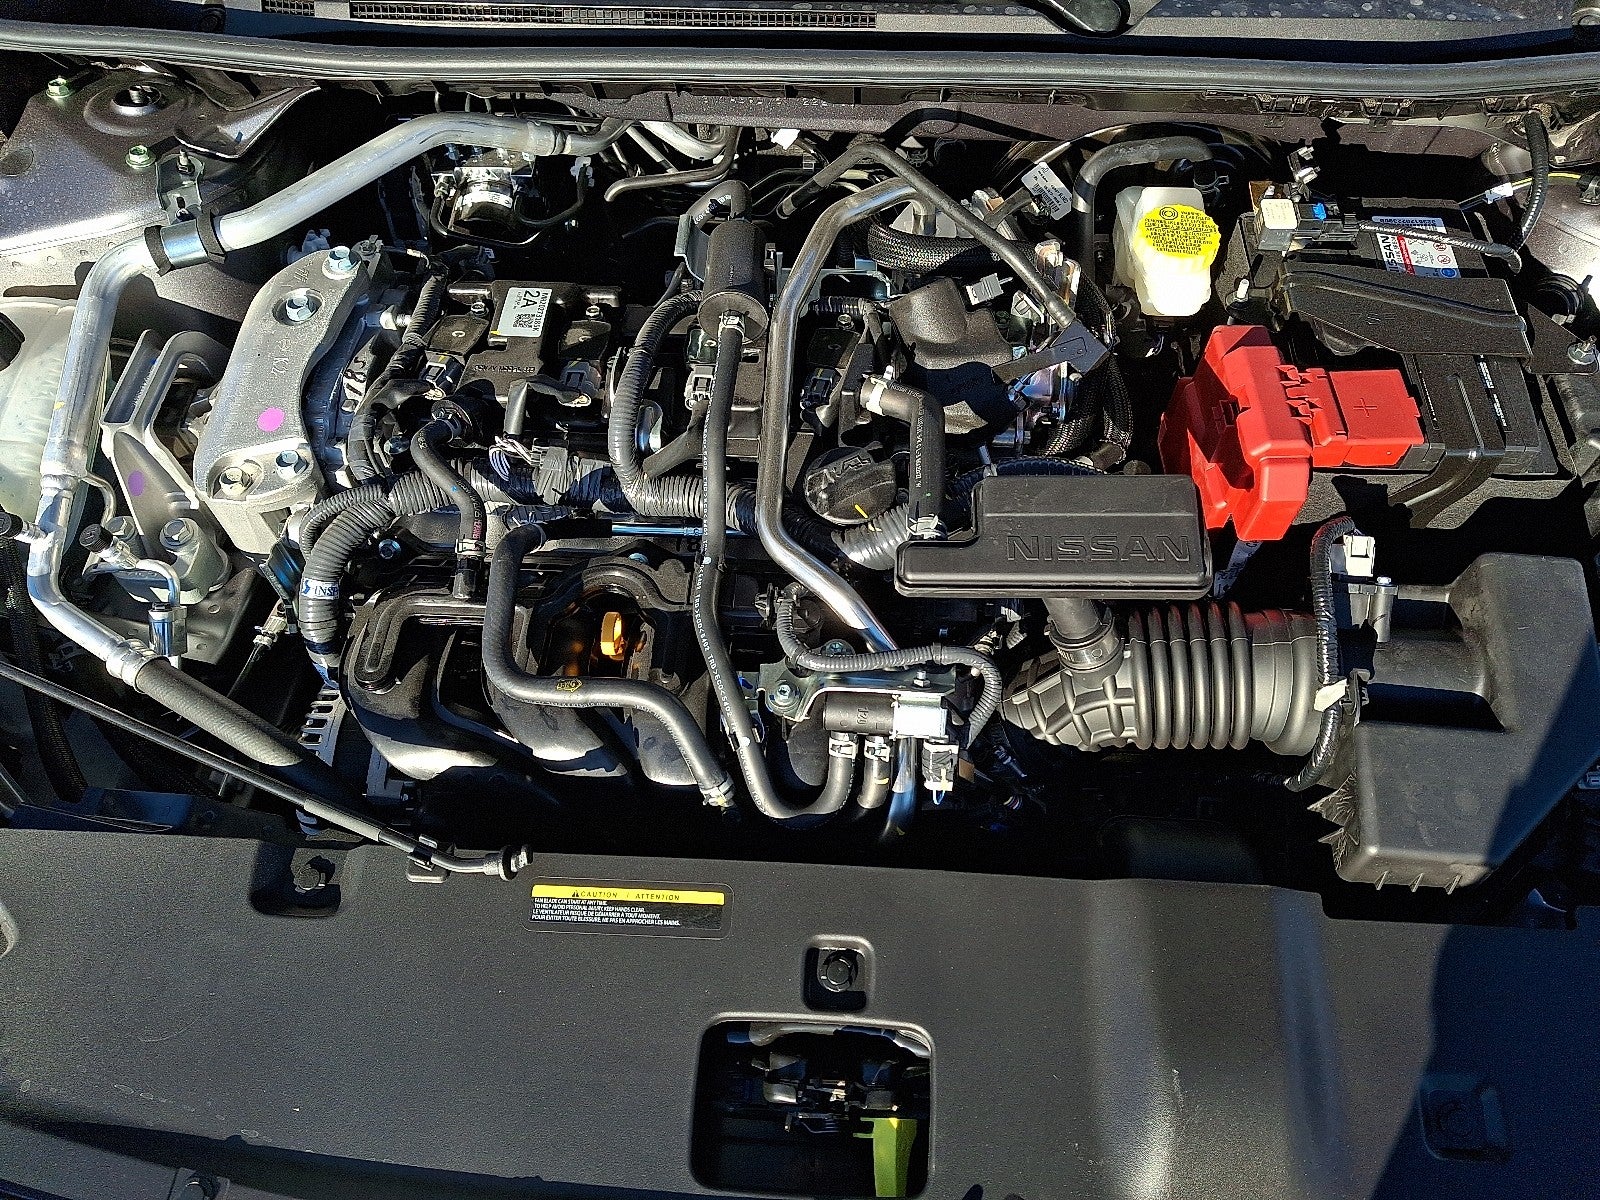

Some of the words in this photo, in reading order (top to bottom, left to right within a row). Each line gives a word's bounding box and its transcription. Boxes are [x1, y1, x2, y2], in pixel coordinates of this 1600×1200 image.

[1380, 235, 1400, 273] ISSAN
[520, 290, 540, 308] 2A
[1007, 535, 1190, 562] NISSAN
[580, 890, 618, 898] CAUTION
[635, 893, 680, 901] ATTENTION
